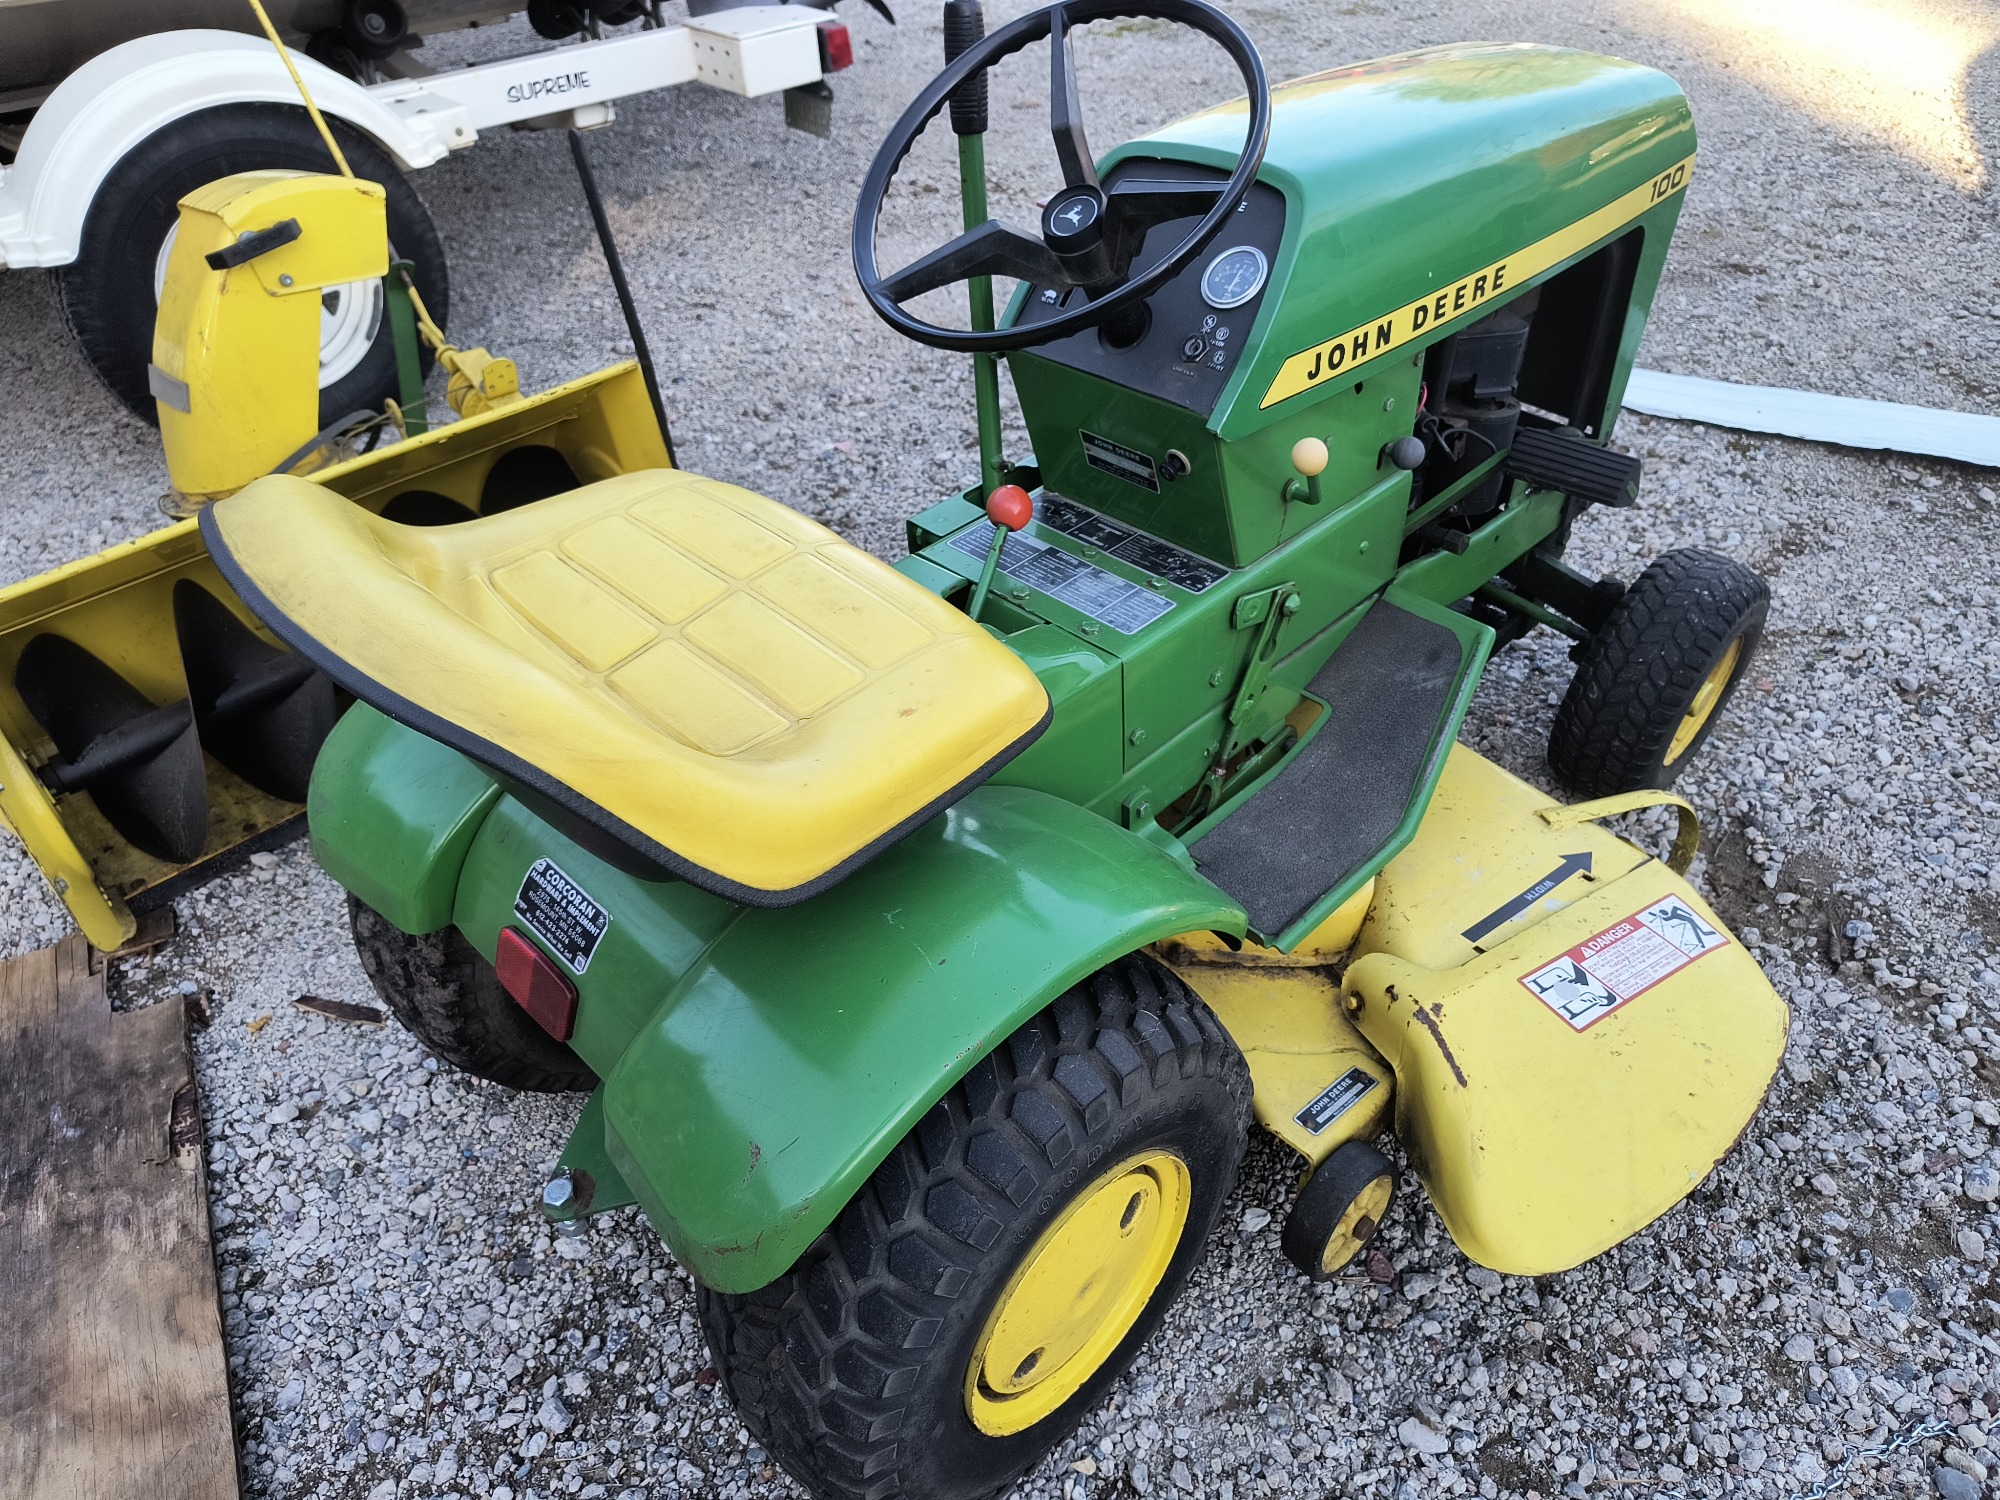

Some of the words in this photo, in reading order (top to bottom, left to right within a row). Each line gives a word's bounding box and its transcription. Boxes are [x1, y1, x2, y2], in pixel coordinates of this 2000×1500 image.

[507, 71, 591, 103] SUPREME
[1650, 164, 1685, 203] 100
[1307, 320, 1393, 381] JOHN
[1412, 265, 1507, 333] DEERE
[1093, 437, 1113, 451] JOHN
[1114, 446, 1140, 461] DEERE
[530, 869, 562, 902] HARDWARE
[560, 897, 567, 907] &
[566, 903, 600, 937] IMPLEMENT
[545, 869, 596, 919] CORCORAN
[1524, 880, 1555, 901] WIDTH
[558, 919, 568, 931] MN
[1589, 922, 1635, 950] DANGER
[1310, 1096, 1330, 1115] JOHN
[1328, 1077, 1353, 1097] DEERE
[1012, 1092, 1203, 1244] GOODYEAR
